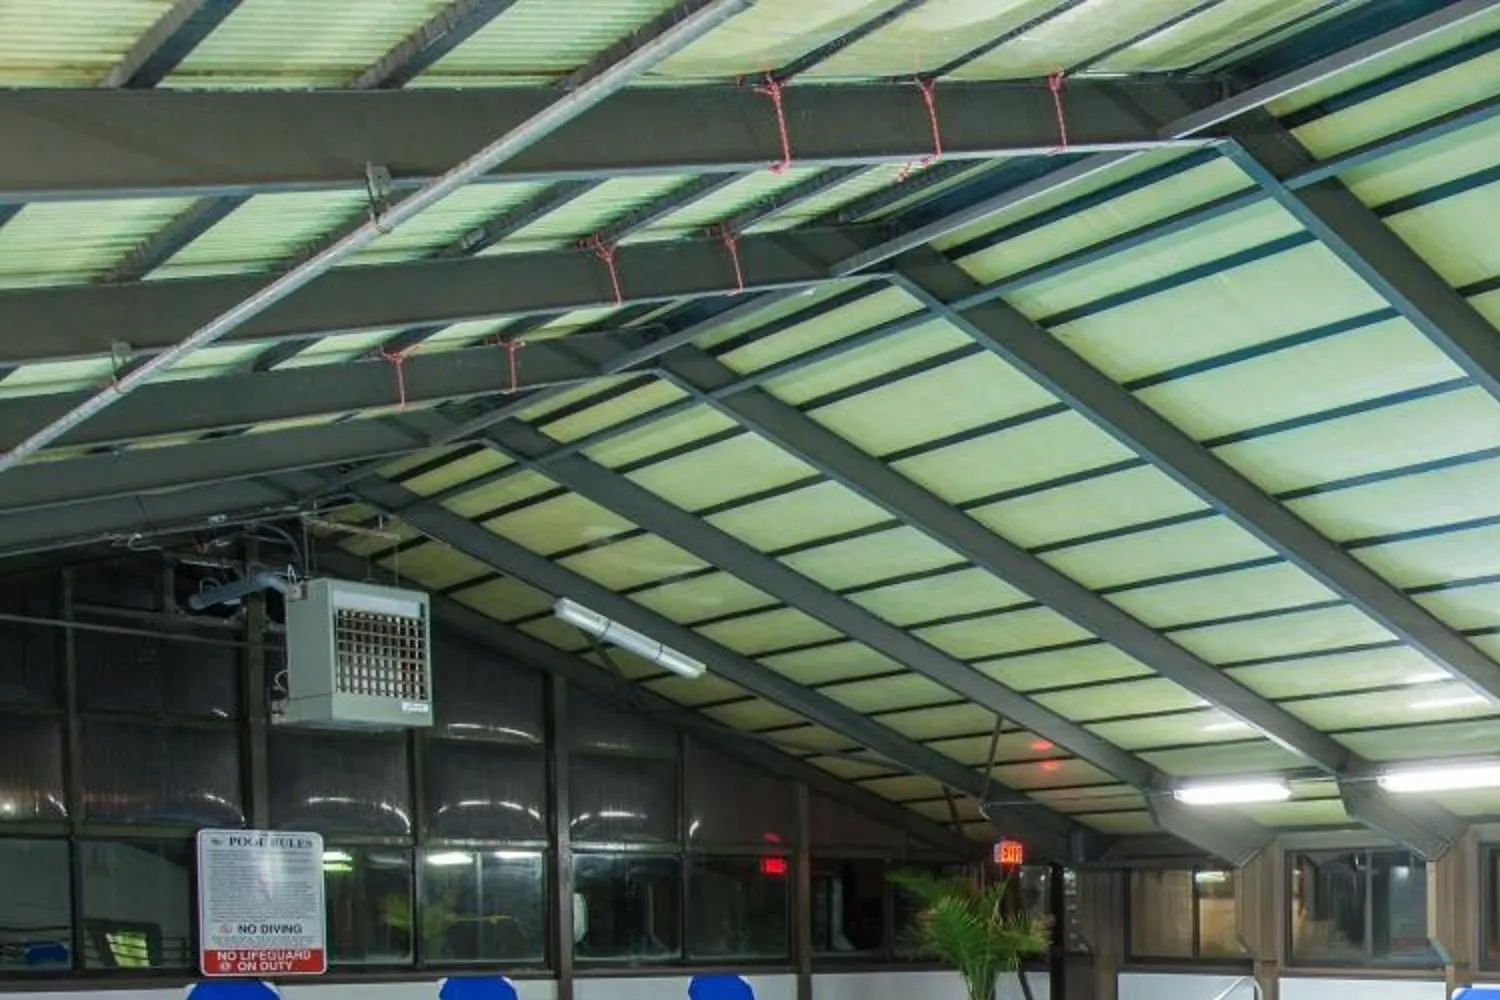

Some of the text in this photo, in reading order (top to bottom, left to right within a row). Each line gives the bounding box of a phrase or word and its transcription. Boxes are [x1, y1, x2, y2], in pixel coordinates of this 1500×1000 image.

[237, 923, 303, 935] NO DIVING
[217, 950, 311, 962] NO LIFEGUARD
[237, 961, 293, 971] ON DUTY
